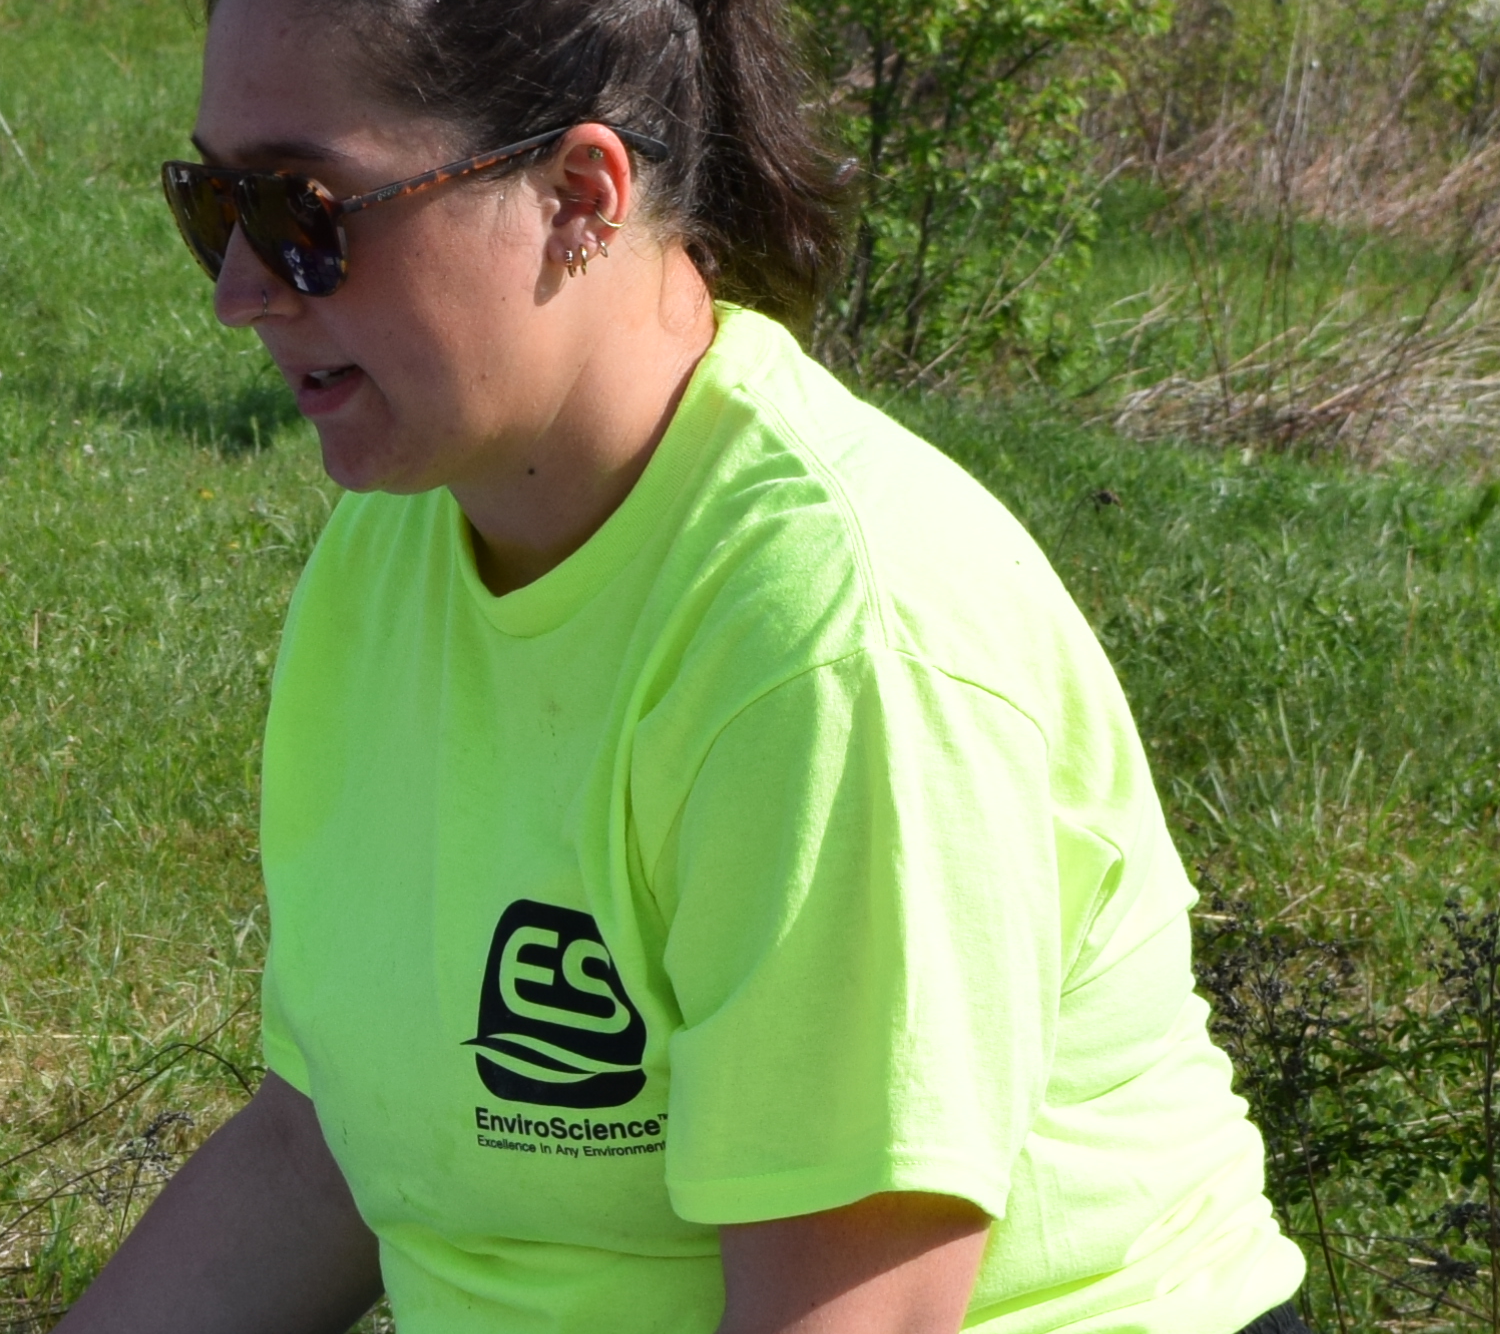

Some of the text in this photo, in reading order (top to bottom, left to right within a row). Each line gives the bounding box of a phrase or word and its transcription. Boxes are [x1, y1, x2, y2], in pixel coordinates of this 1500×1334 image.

[477, 1134, 667, 1159] Excellence In Any Environment
